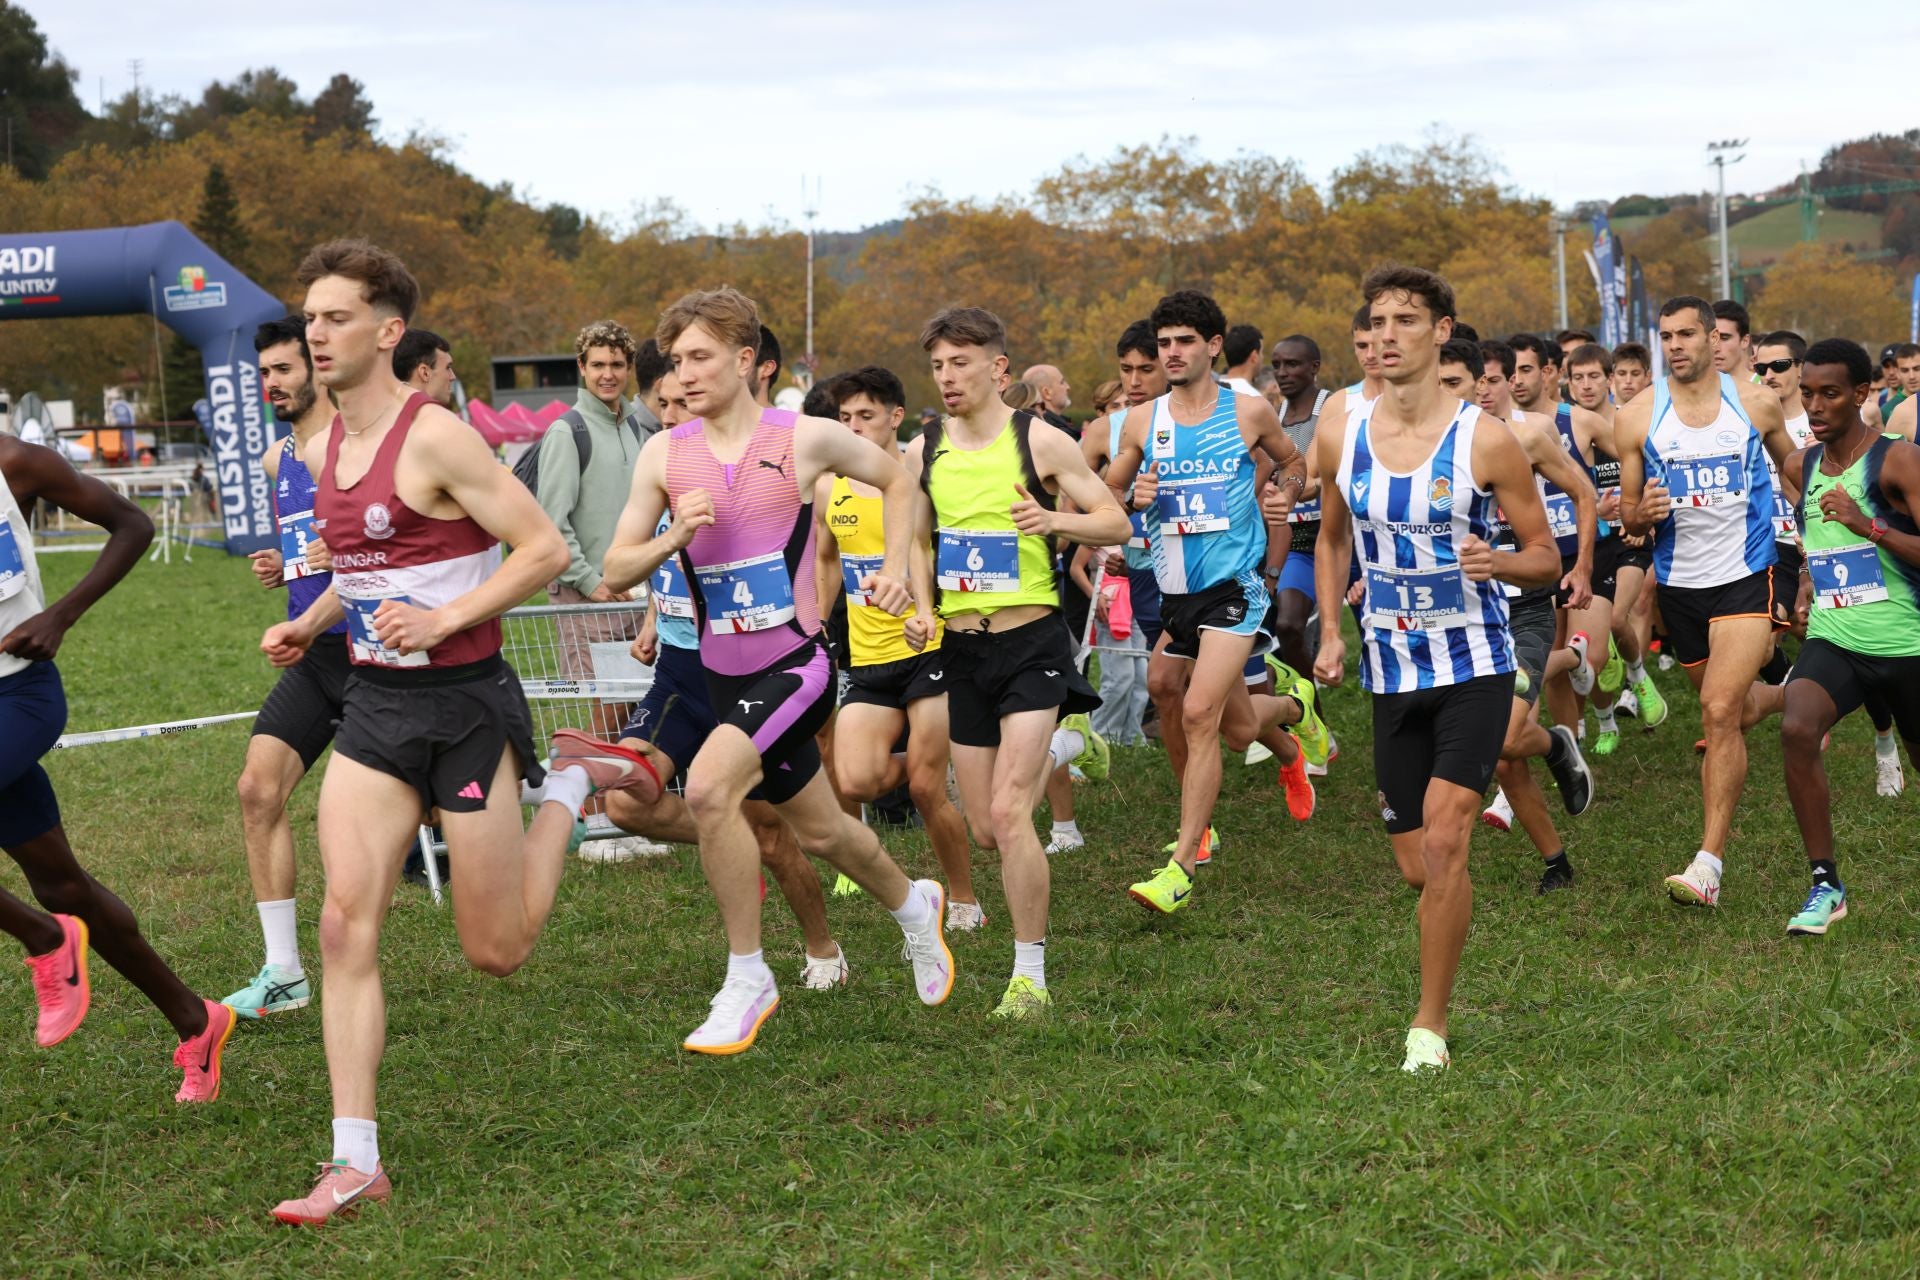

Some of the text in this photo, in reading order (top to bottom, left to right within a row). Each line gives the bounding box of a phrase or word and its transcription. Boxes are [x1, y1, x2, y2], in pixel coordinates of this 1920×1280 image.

[238, 360, 263, 455] COUNTRY
[208, 364, 249, 539] EUSKADI
[1595, 462, 1620, 471] VICKY
[1684, 465, 1730, 489] 108
[248, 457, 272, 537] BASQUE
[1175, 493, 1206, 516] 14
[831, 515, 858, 525] INDO
[1387, 523, 1453, 534] GIPUZKOA
[295, 530, 308, 555] 3
[966, 548, 984, 571] 6
[659, 569, 672, 593] 7
[945, 570, 1010, 579] CALLUM MORGAN
[1833, 563, 1848, 587] 9
[732, 581, 754, 607] 4
[1395, 585, 1434, 610] 13
[1840, 582, 1878, 594] ESCAMILLA
[740, 602, 776, 617] GRIGGS
[1376, 606, 1458, 618] MARTÍN SEGUROLA
[160, 724, 198, 734] Donostia
